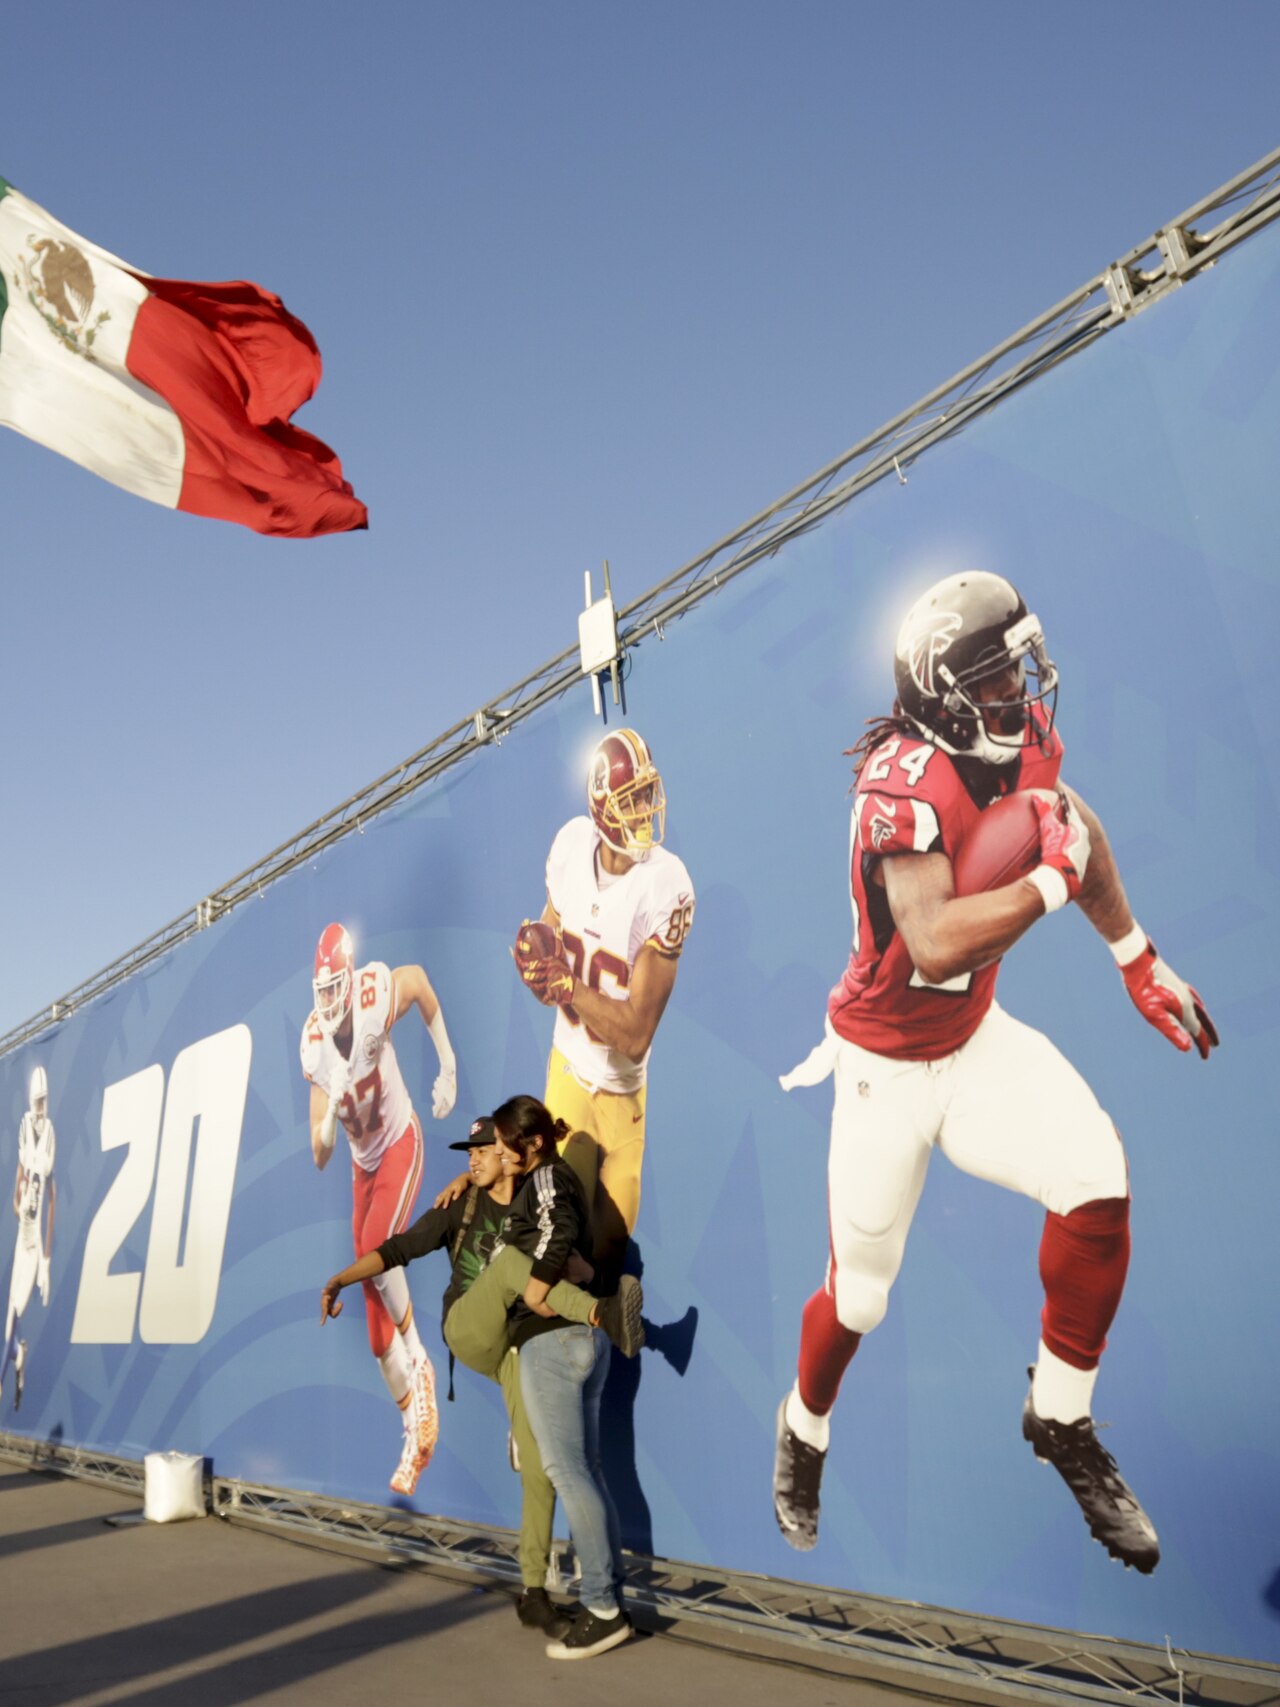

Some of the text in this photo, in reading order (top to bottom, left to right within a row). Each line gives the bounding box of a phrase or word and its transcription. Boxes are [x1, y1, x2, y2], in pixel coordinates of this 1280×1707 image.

[866, 738, 936, 788] 24
[360, 971, 376, 1010] 87
[70, 1023, 253, 1345] 20
